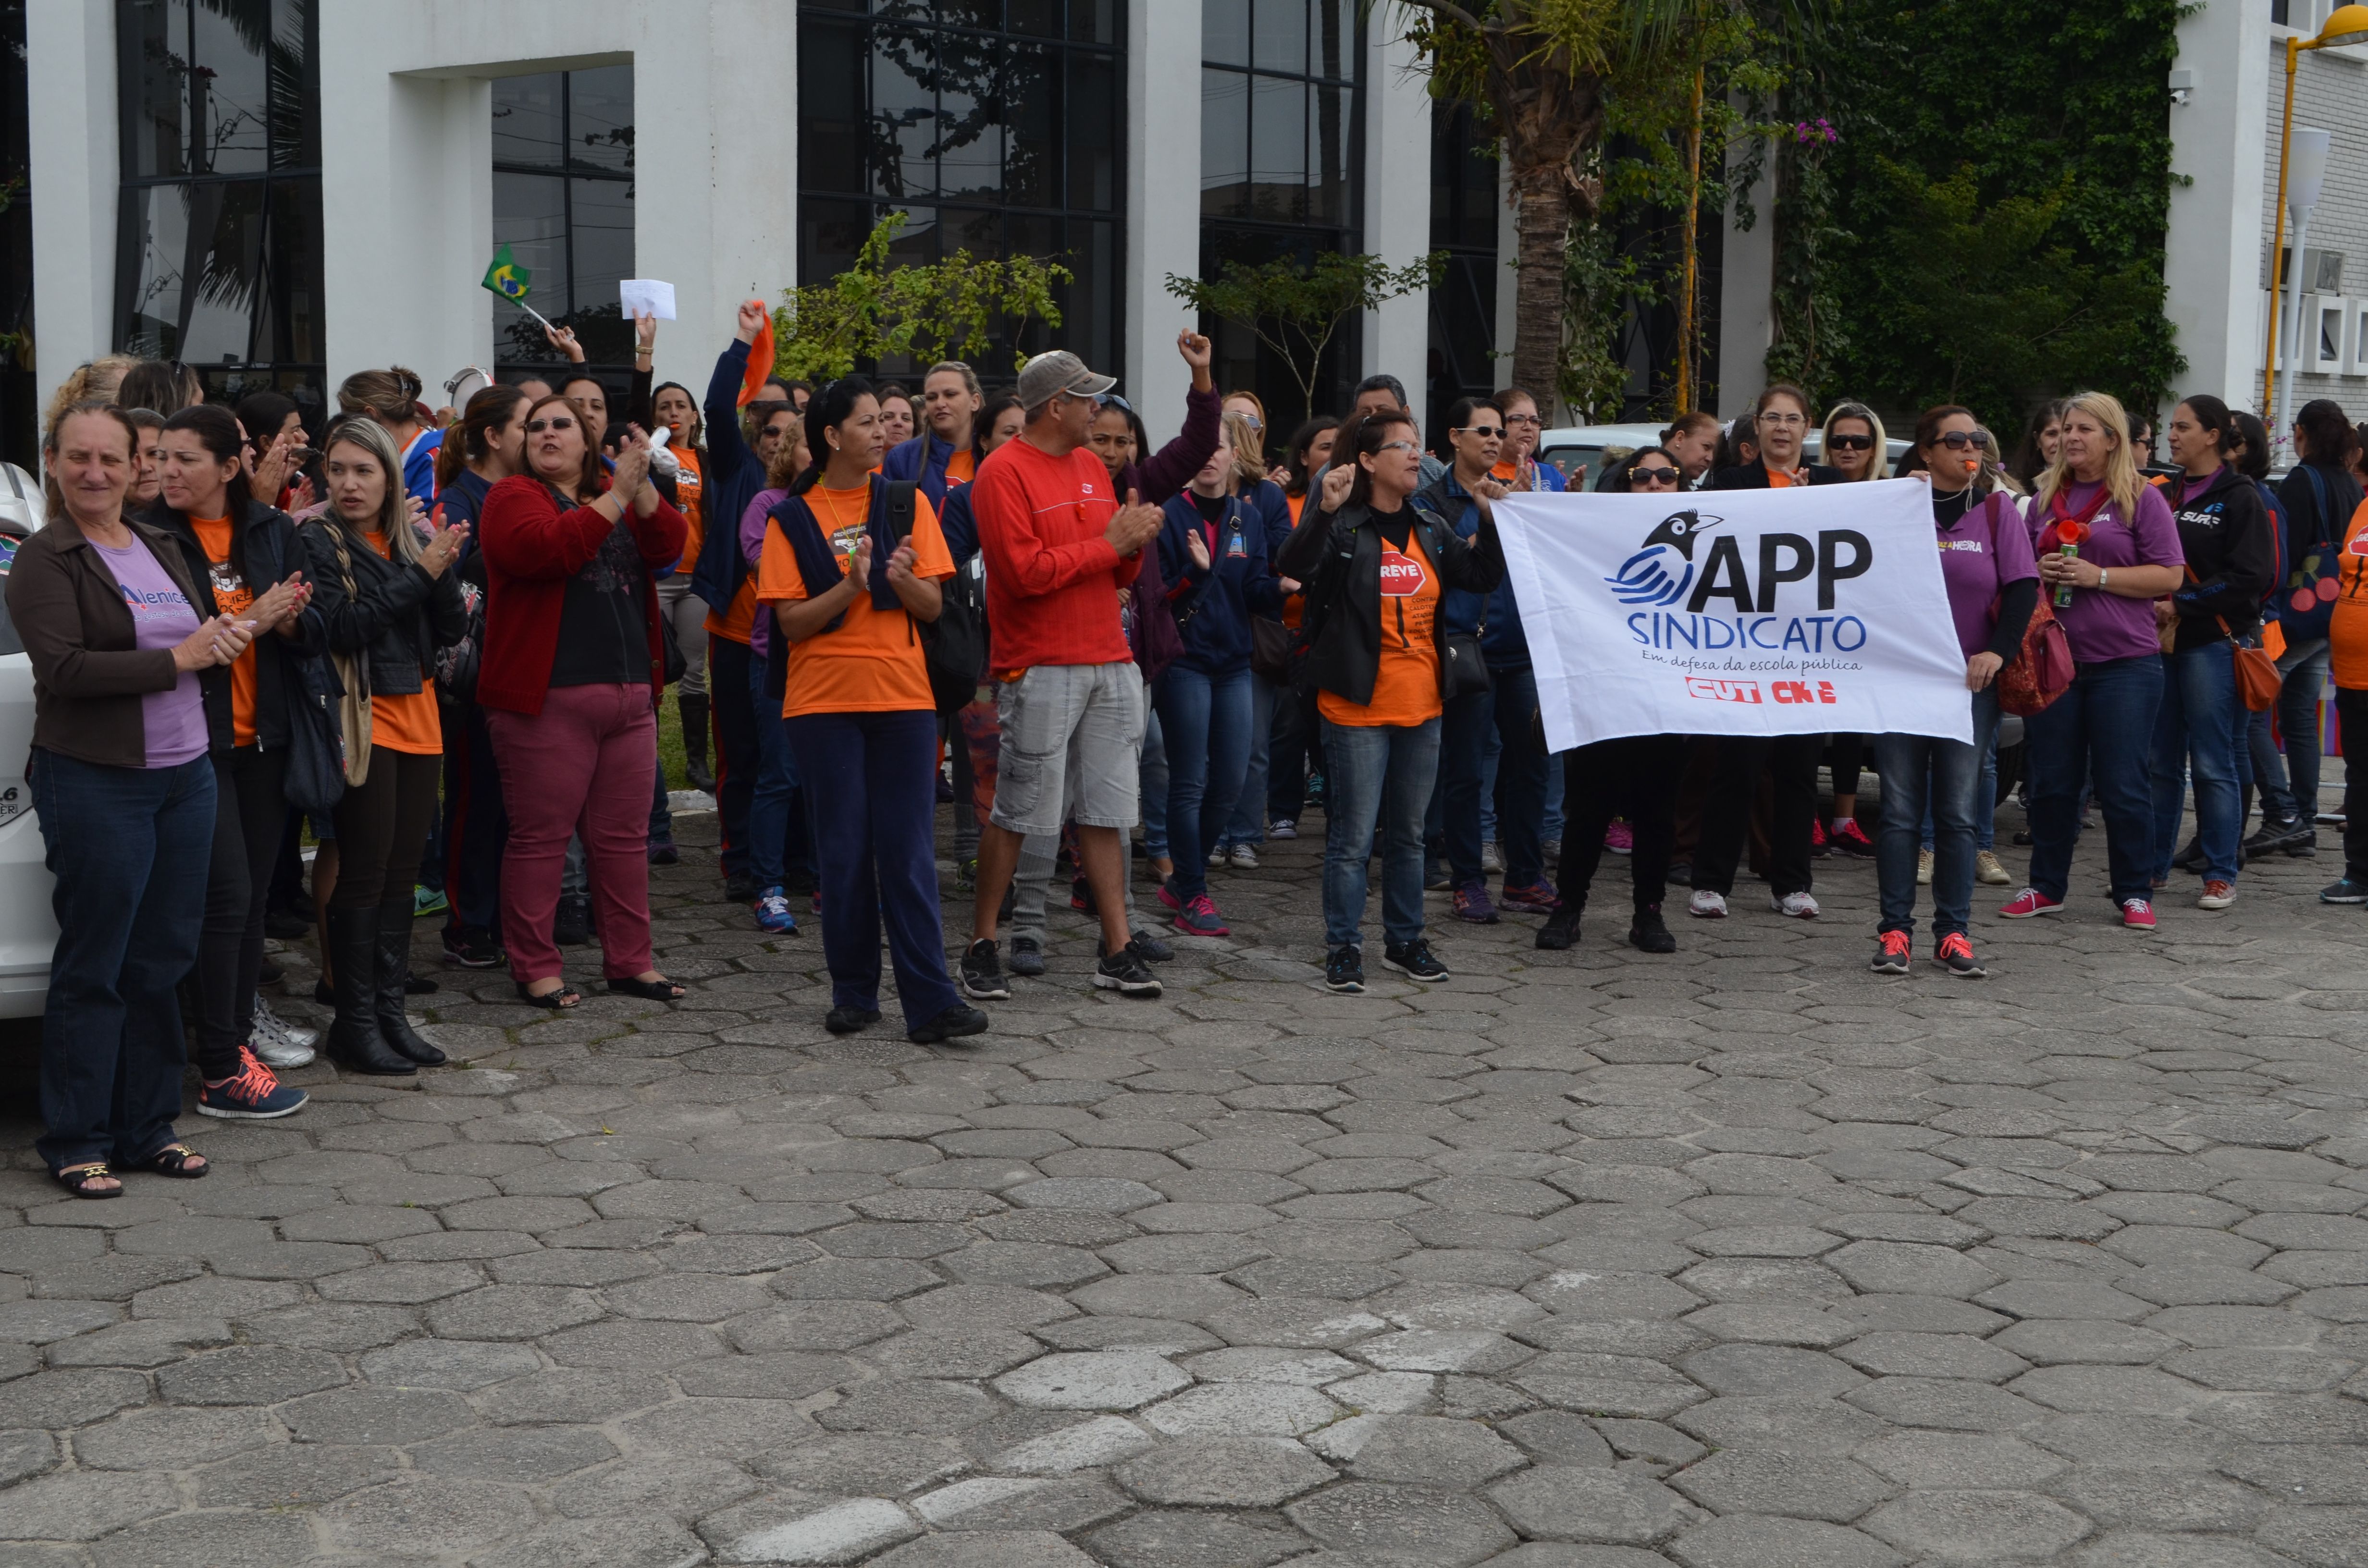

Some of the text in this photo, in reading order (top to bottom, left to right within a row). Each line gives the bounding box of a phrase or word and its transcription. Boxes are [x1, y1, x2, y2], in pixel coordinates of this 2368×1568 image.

[1952, 540, 1983, 553] HORA
[1686, 528, 1873, 613] APP
[144, 611, 169, 623] gostoso
[1628, 612, 1867, 653] SINDICATO
[1642, 649, 1863, 676] Em defesa da escola pública
[1687, 677, 1761, 703] CUT
